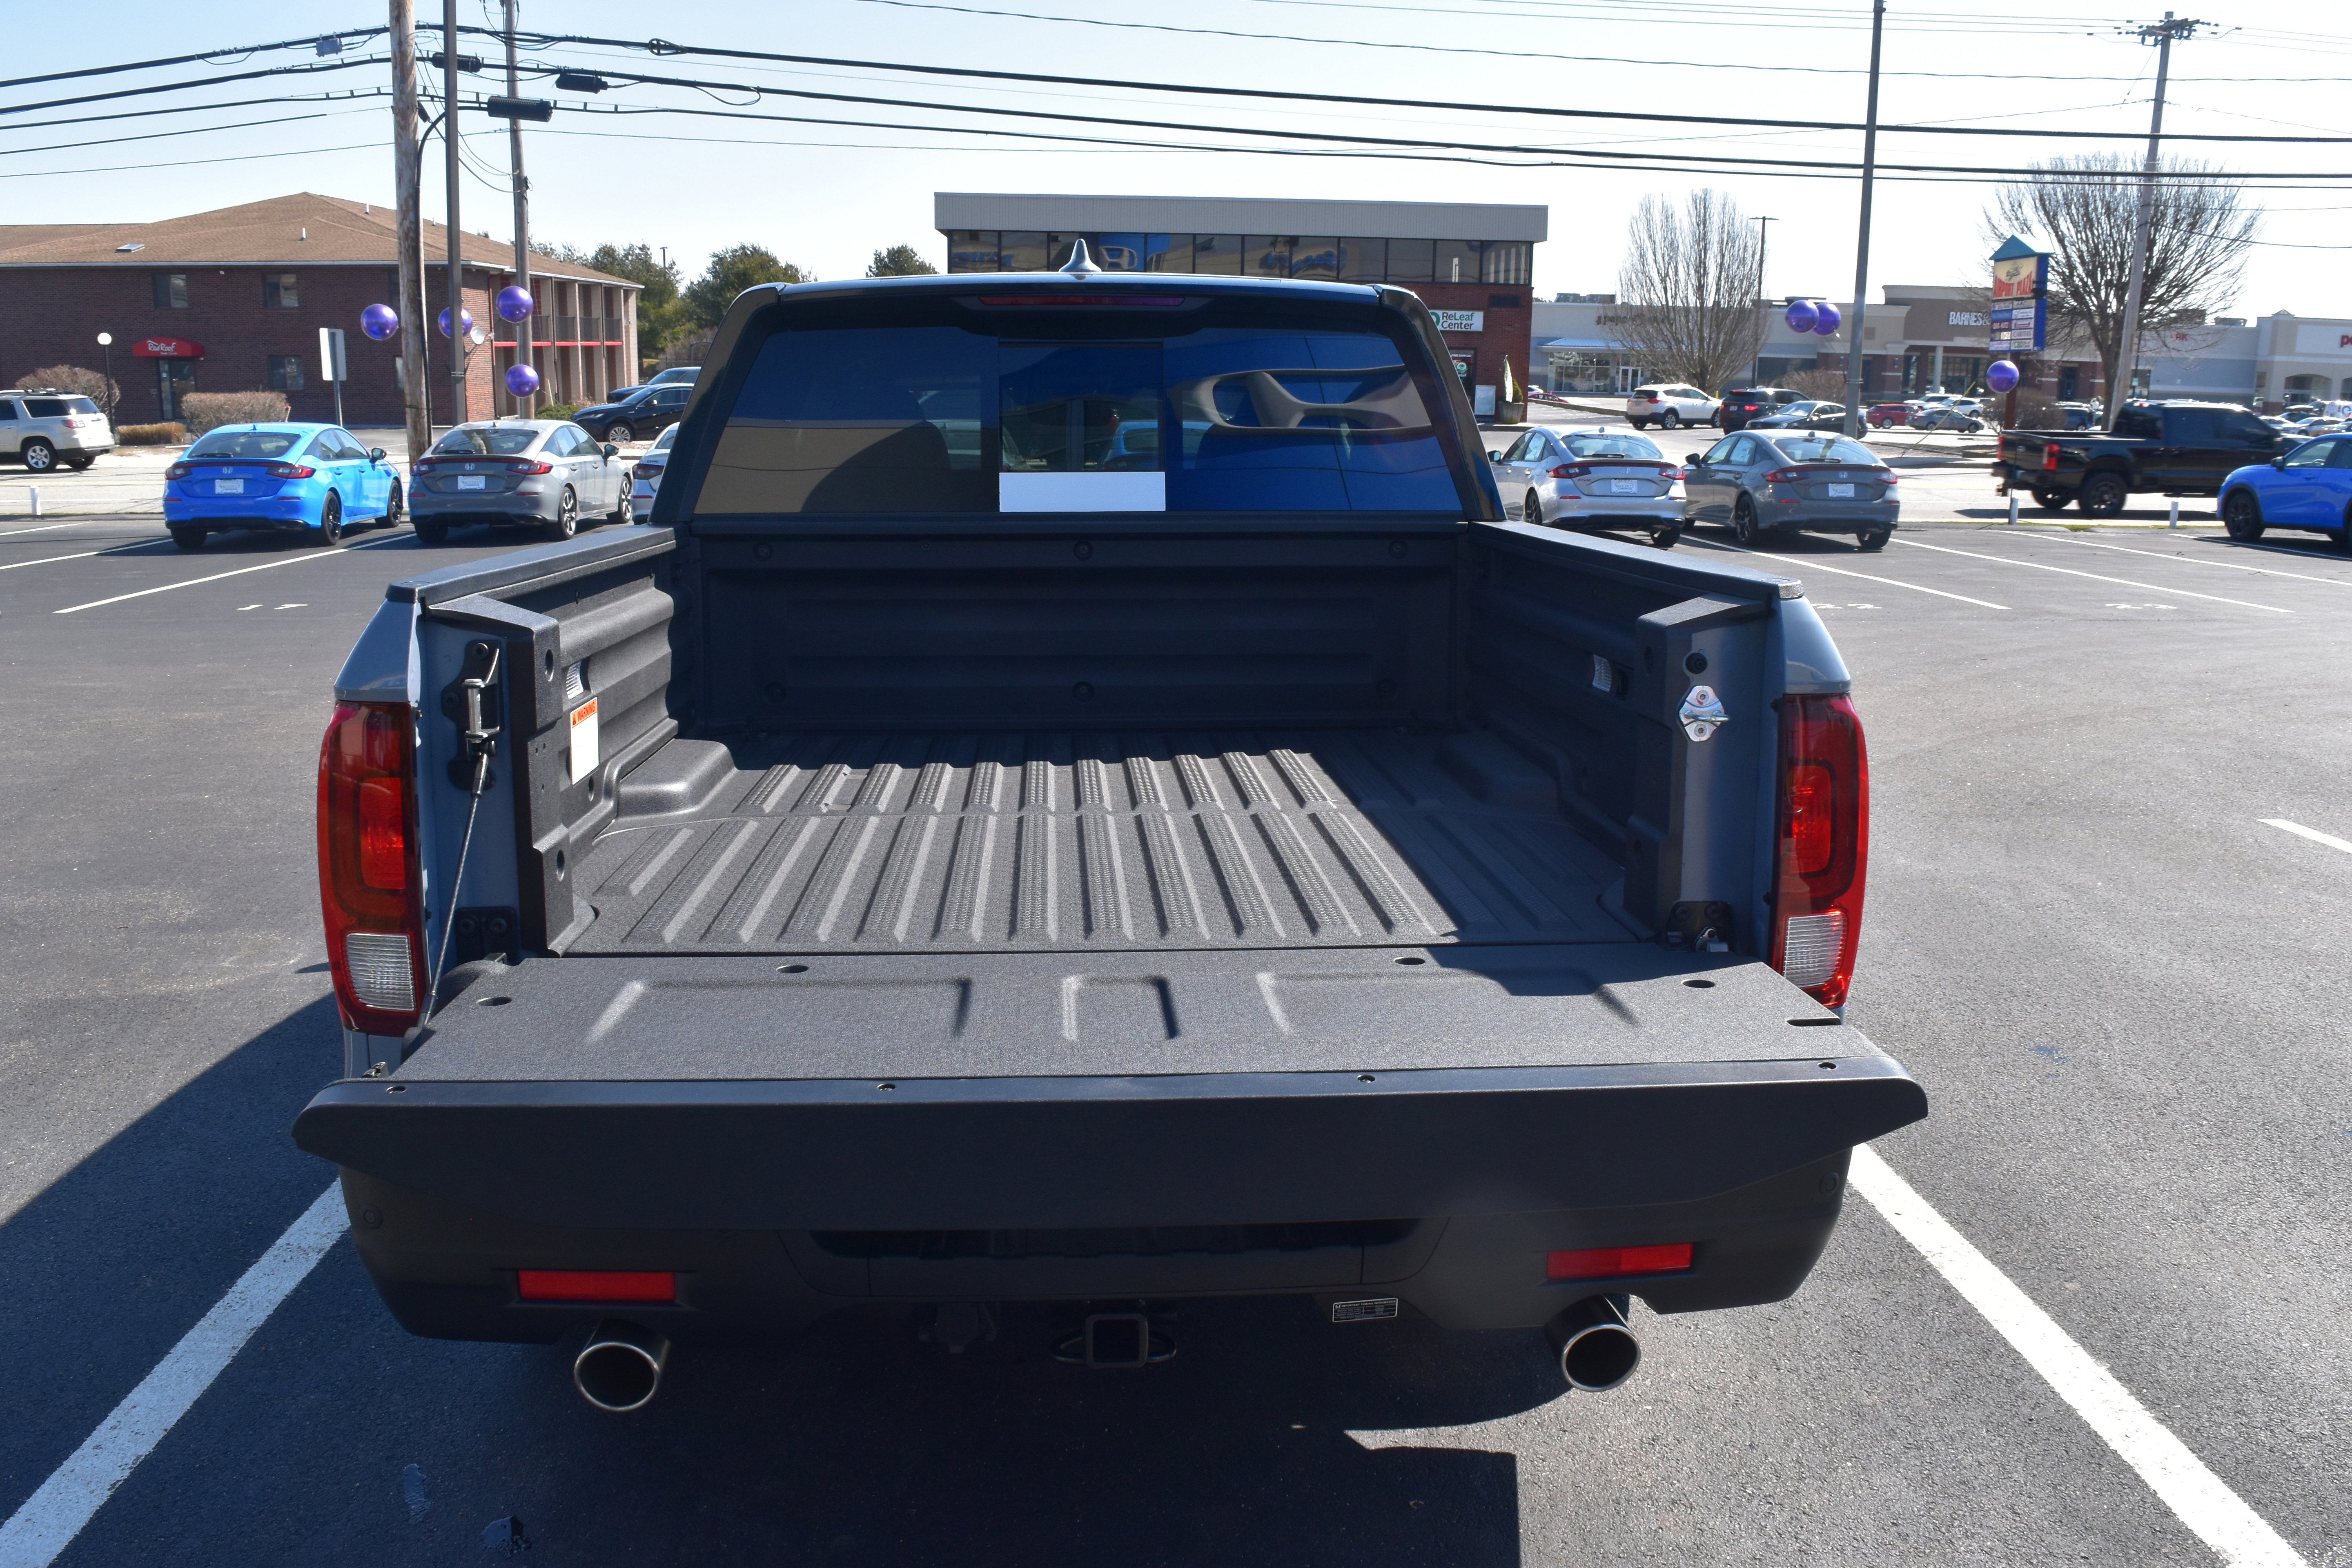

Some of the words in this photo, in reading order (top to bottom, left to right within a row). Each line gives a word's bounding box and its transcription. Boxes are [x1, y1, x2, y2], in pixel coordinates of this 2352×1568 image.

[1442, 312, 1474, 321] ReLeaf
[1441, 321, 1474, 330] Center
[577, 702, 595, 722] WARNING
